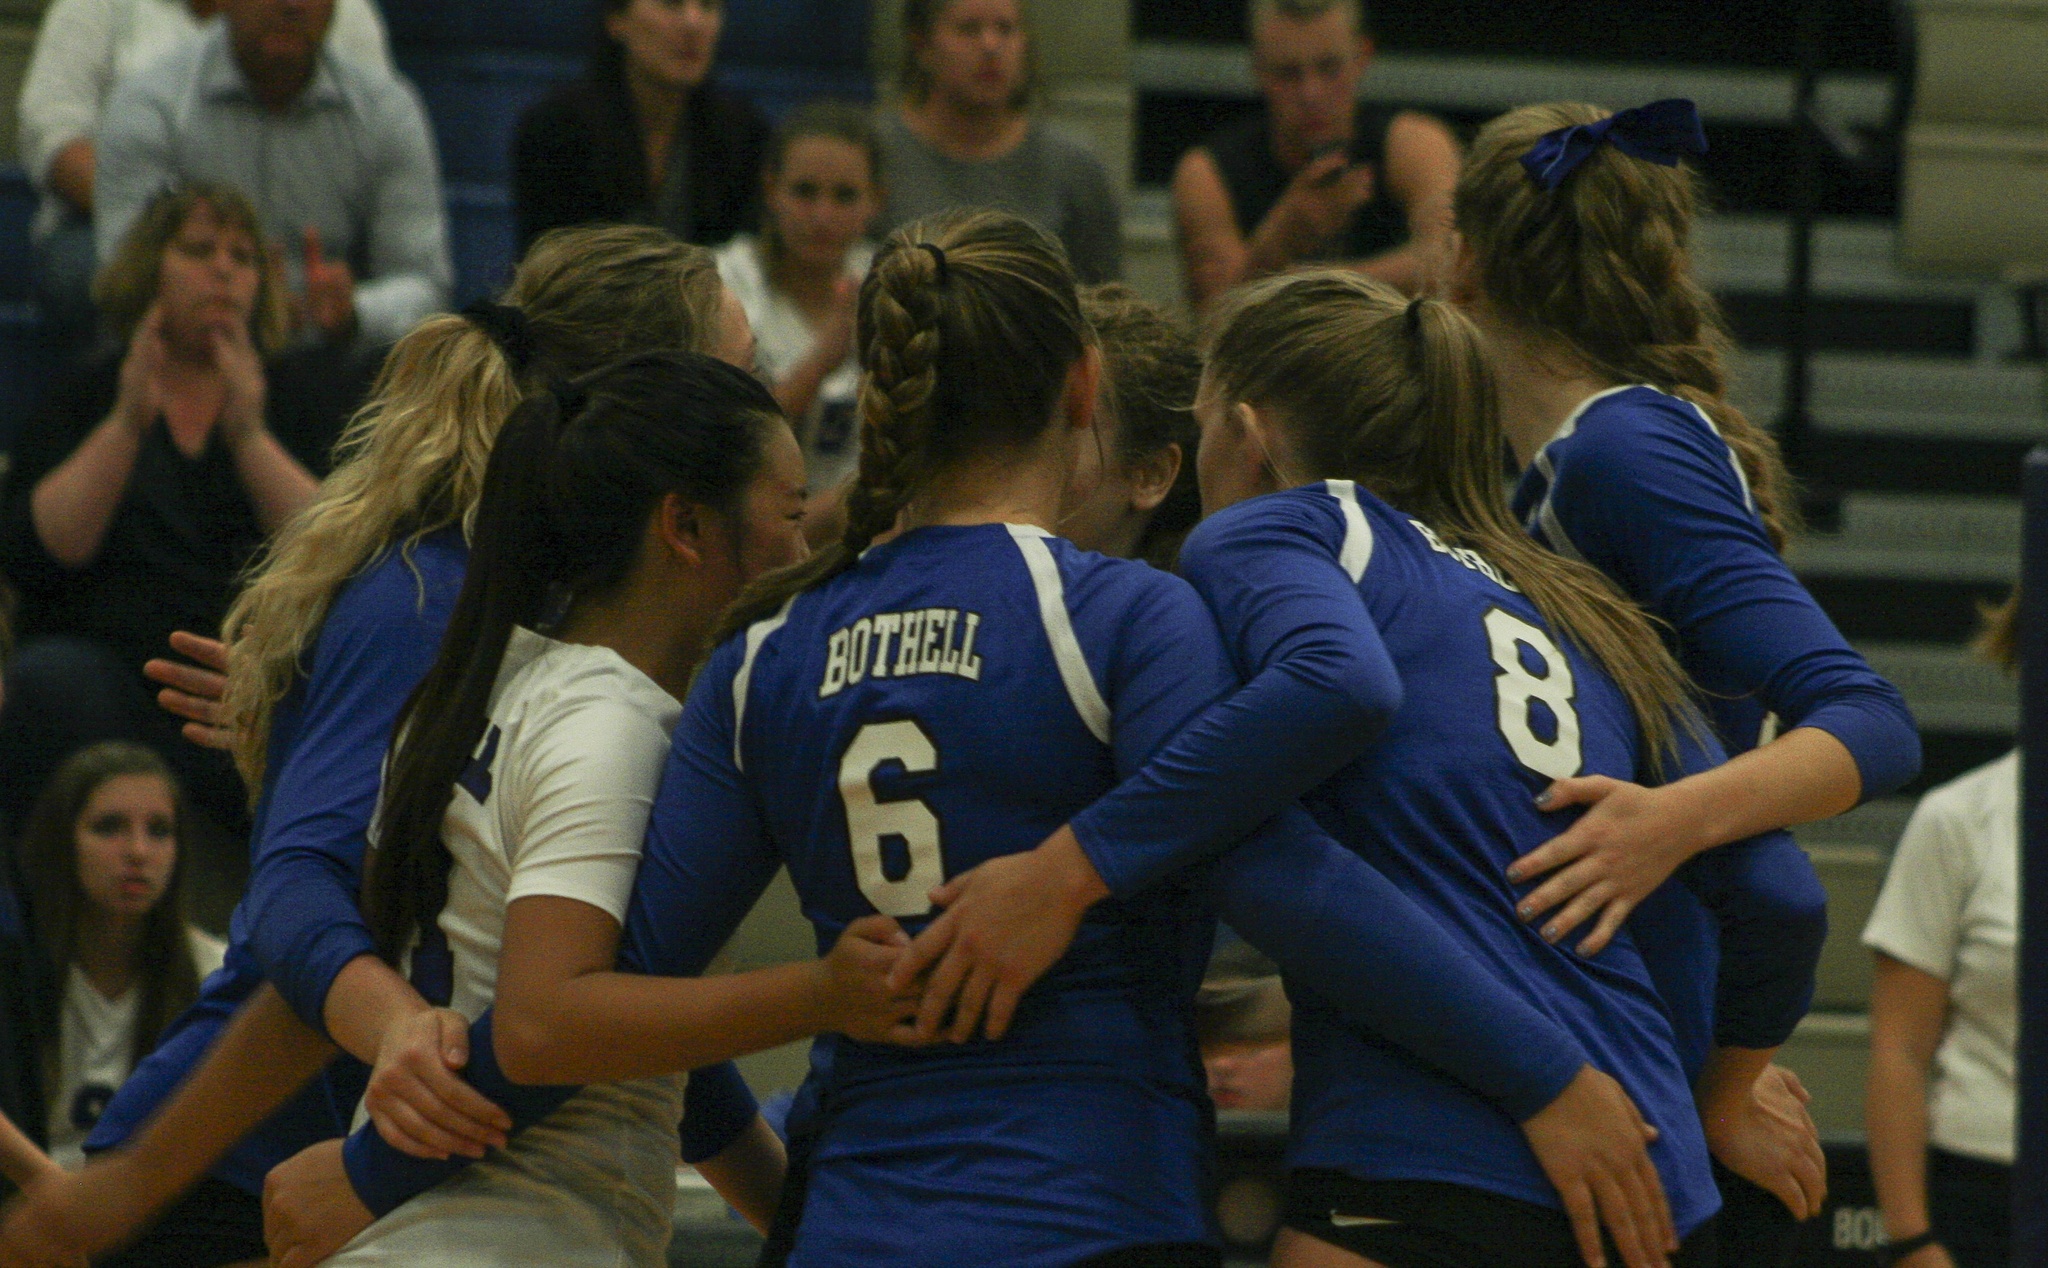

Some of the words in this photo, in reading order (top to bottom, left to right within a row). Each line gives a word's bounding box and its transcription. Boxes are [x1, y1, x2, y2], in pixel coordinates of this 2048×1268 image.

[817, 607, 982, 698] BOTHELL
[1483, 607, 1582, 782] 8
[838, 718, 945, 917] 6
